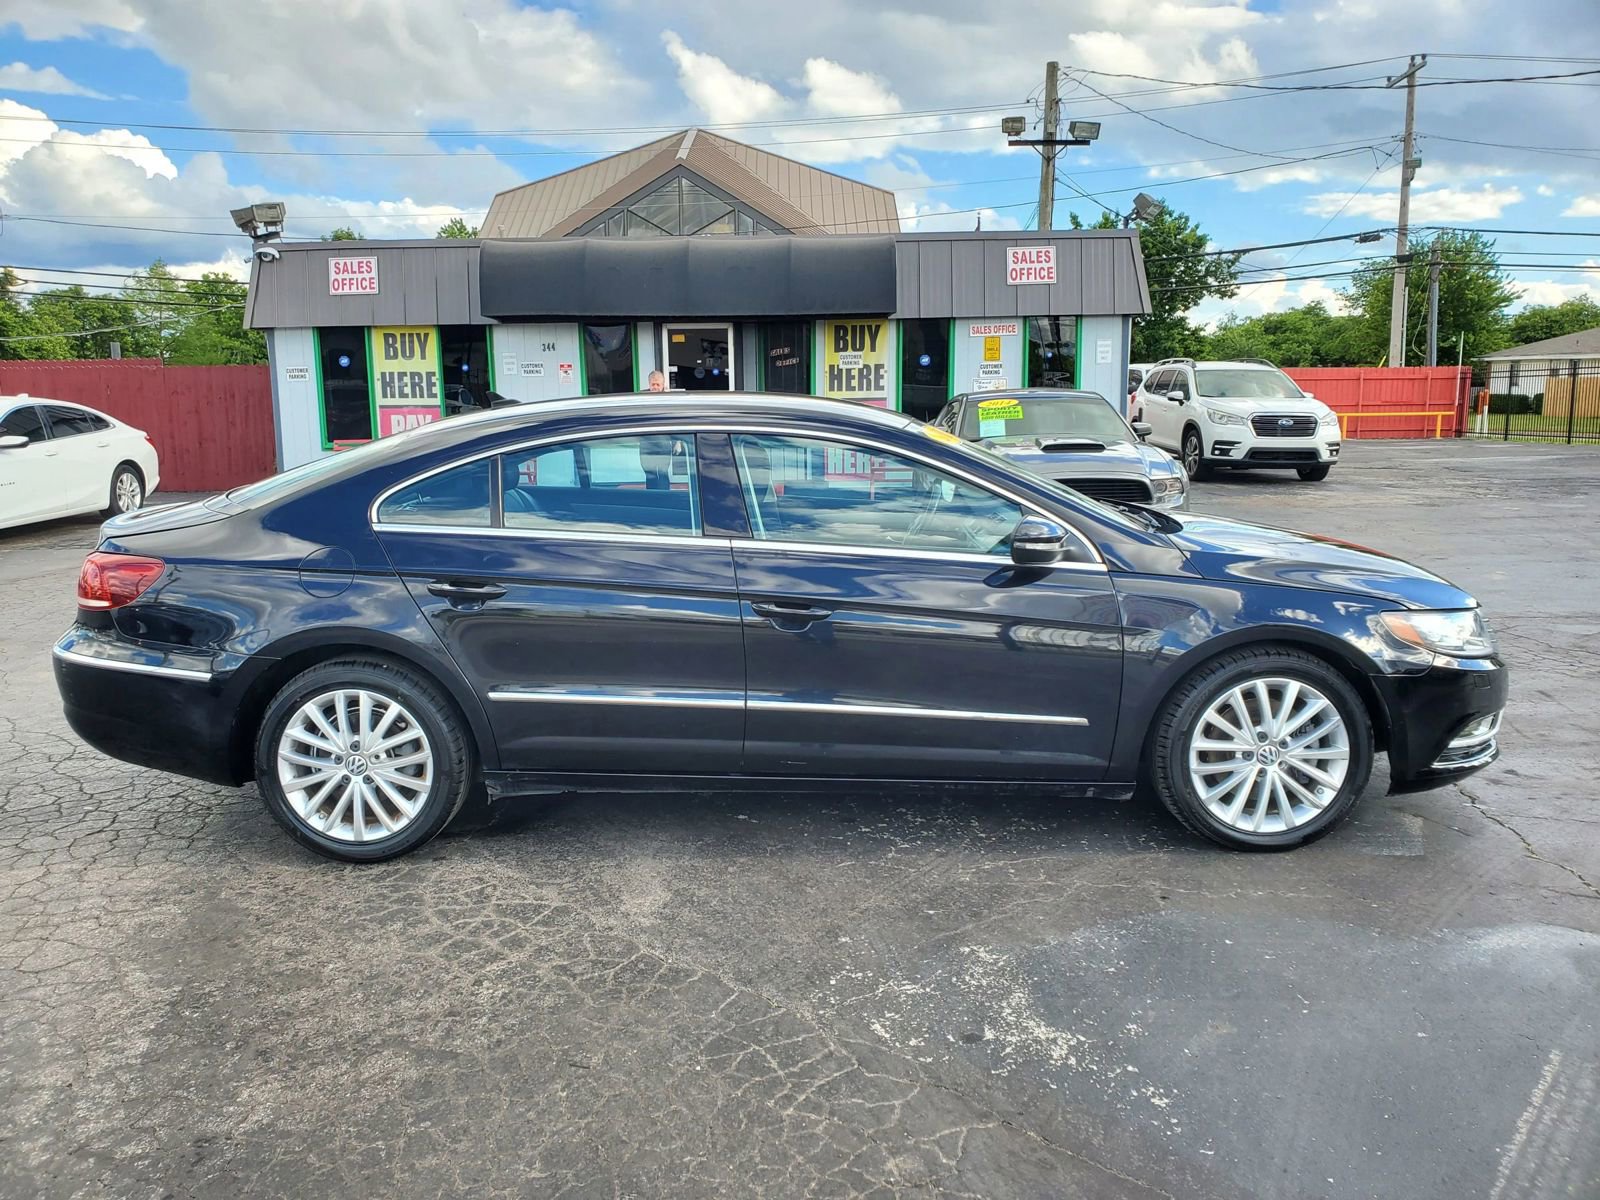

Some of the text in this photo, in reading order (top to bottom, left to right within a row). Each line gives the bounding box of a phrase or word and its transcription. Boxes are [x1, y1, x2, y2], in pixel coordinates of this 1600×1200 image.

[1012, 250, 1051, 265] SALES
[334, 260, 373, 275] SALES
[1010, 266, 1054, 281] OFFICE
[332, 277, 376, 291] OFFICE
[971, 324, 1016, 335] SALES OFFICE
[834, 324, 881, 353] BUY
[383, 332, 430, 361] BUY
[541, 342, 556, 352] 344
[381, 371, 438, 399] HERE
[828, 363, 885, 392] HERE
